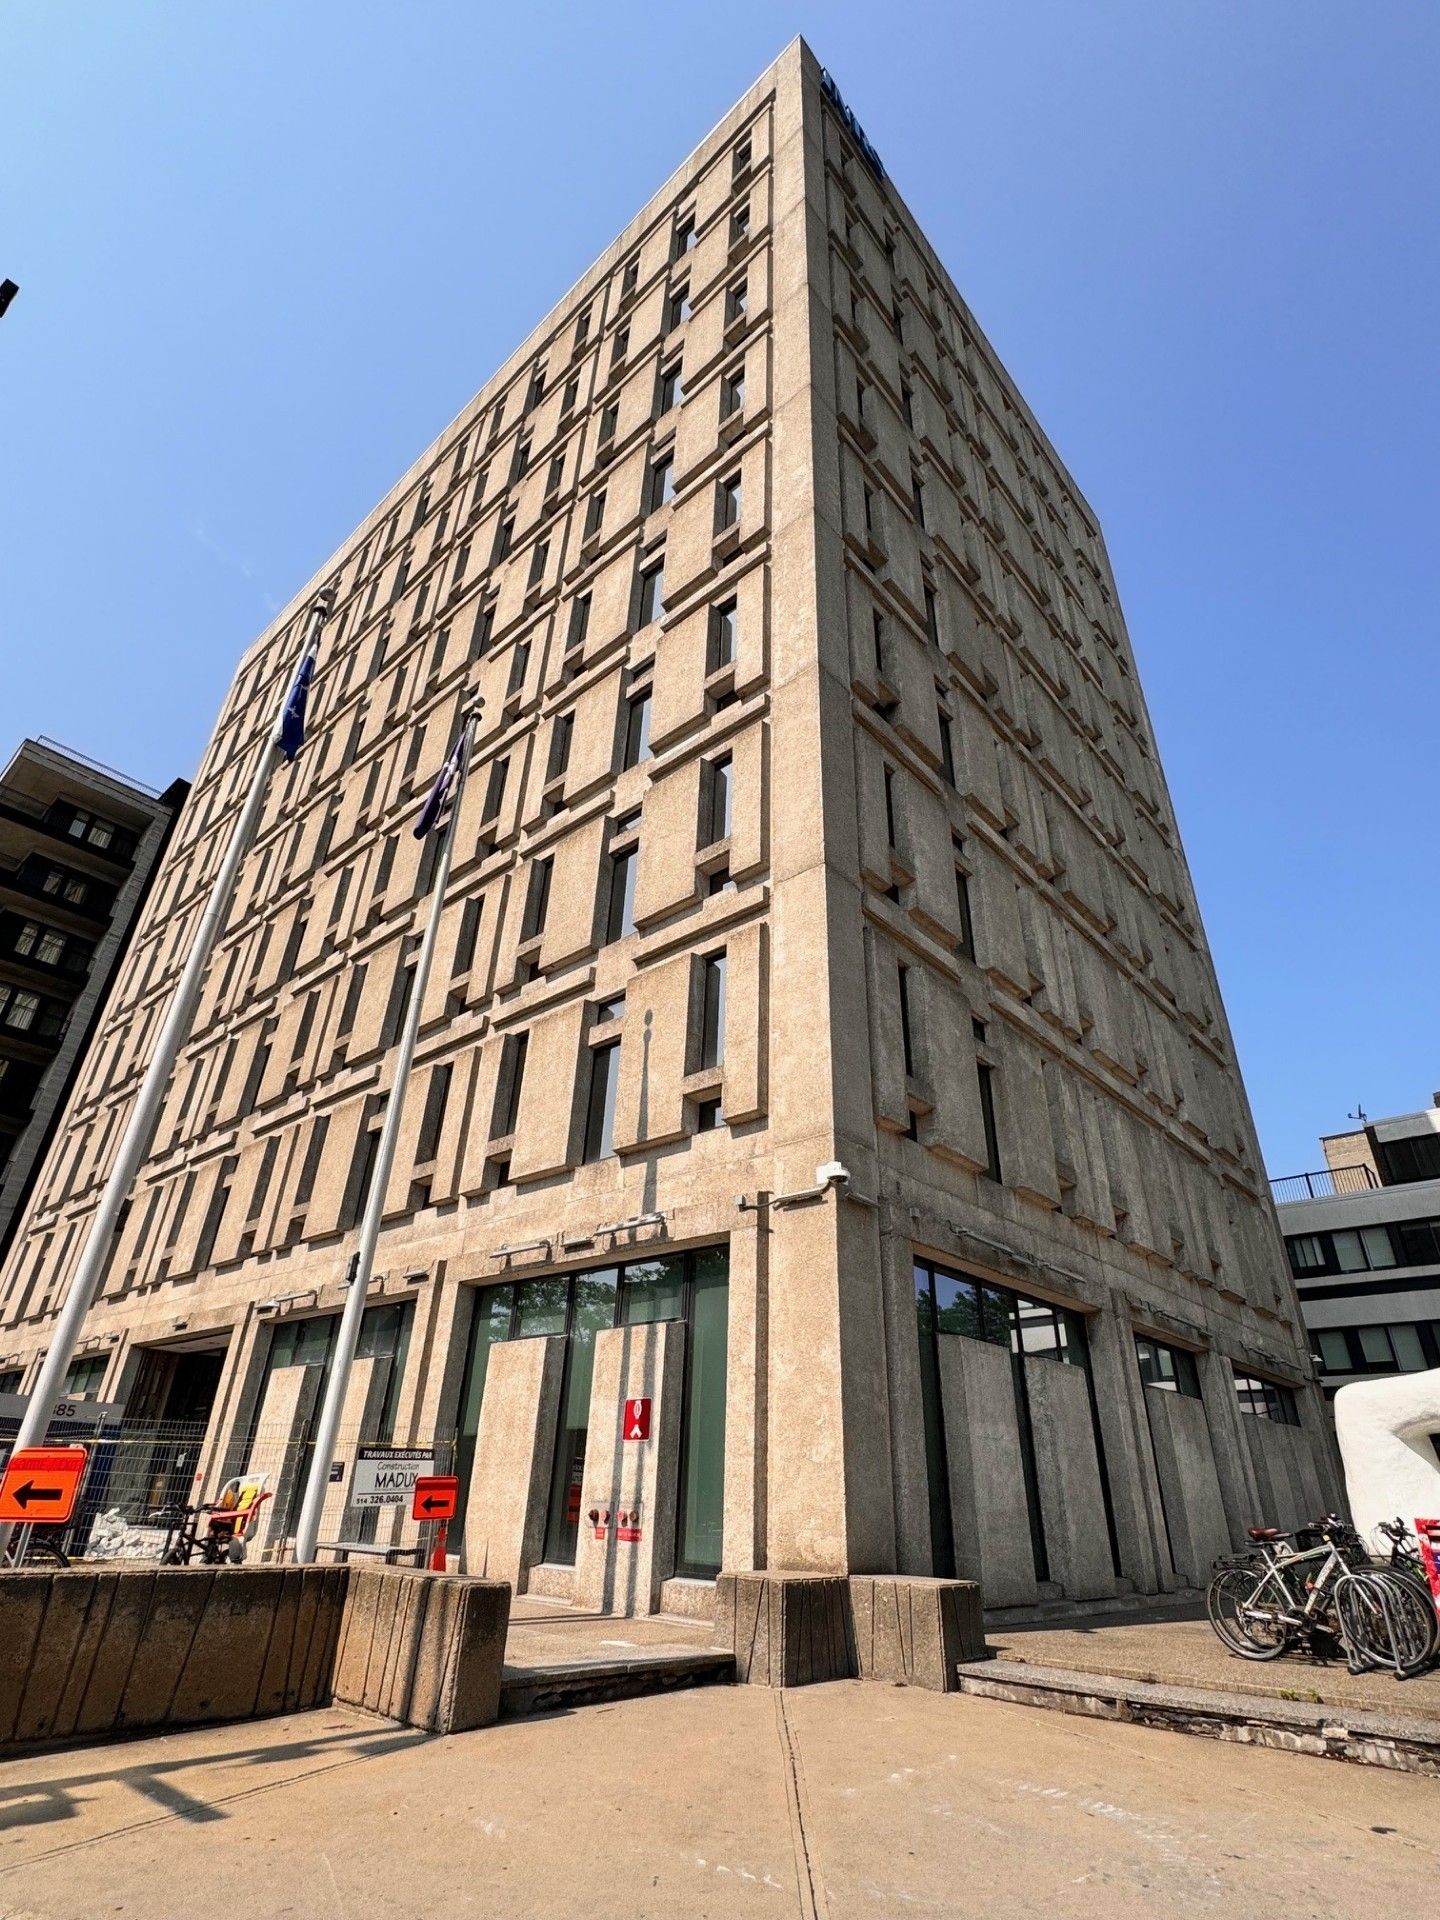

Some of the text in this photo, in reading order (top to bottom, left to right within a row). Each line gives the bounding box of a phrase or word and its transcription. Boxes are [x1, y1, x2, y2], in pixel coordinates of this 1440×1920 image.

[363, 1450, 394, 1459] TRAVAUX
[422, 1451, 432, 1459] PAR
[377, 1461, 420, 1471] Construction
[374, 1472, 419, 1488] MADUX
[356, 1497, 368, 1505] 514
